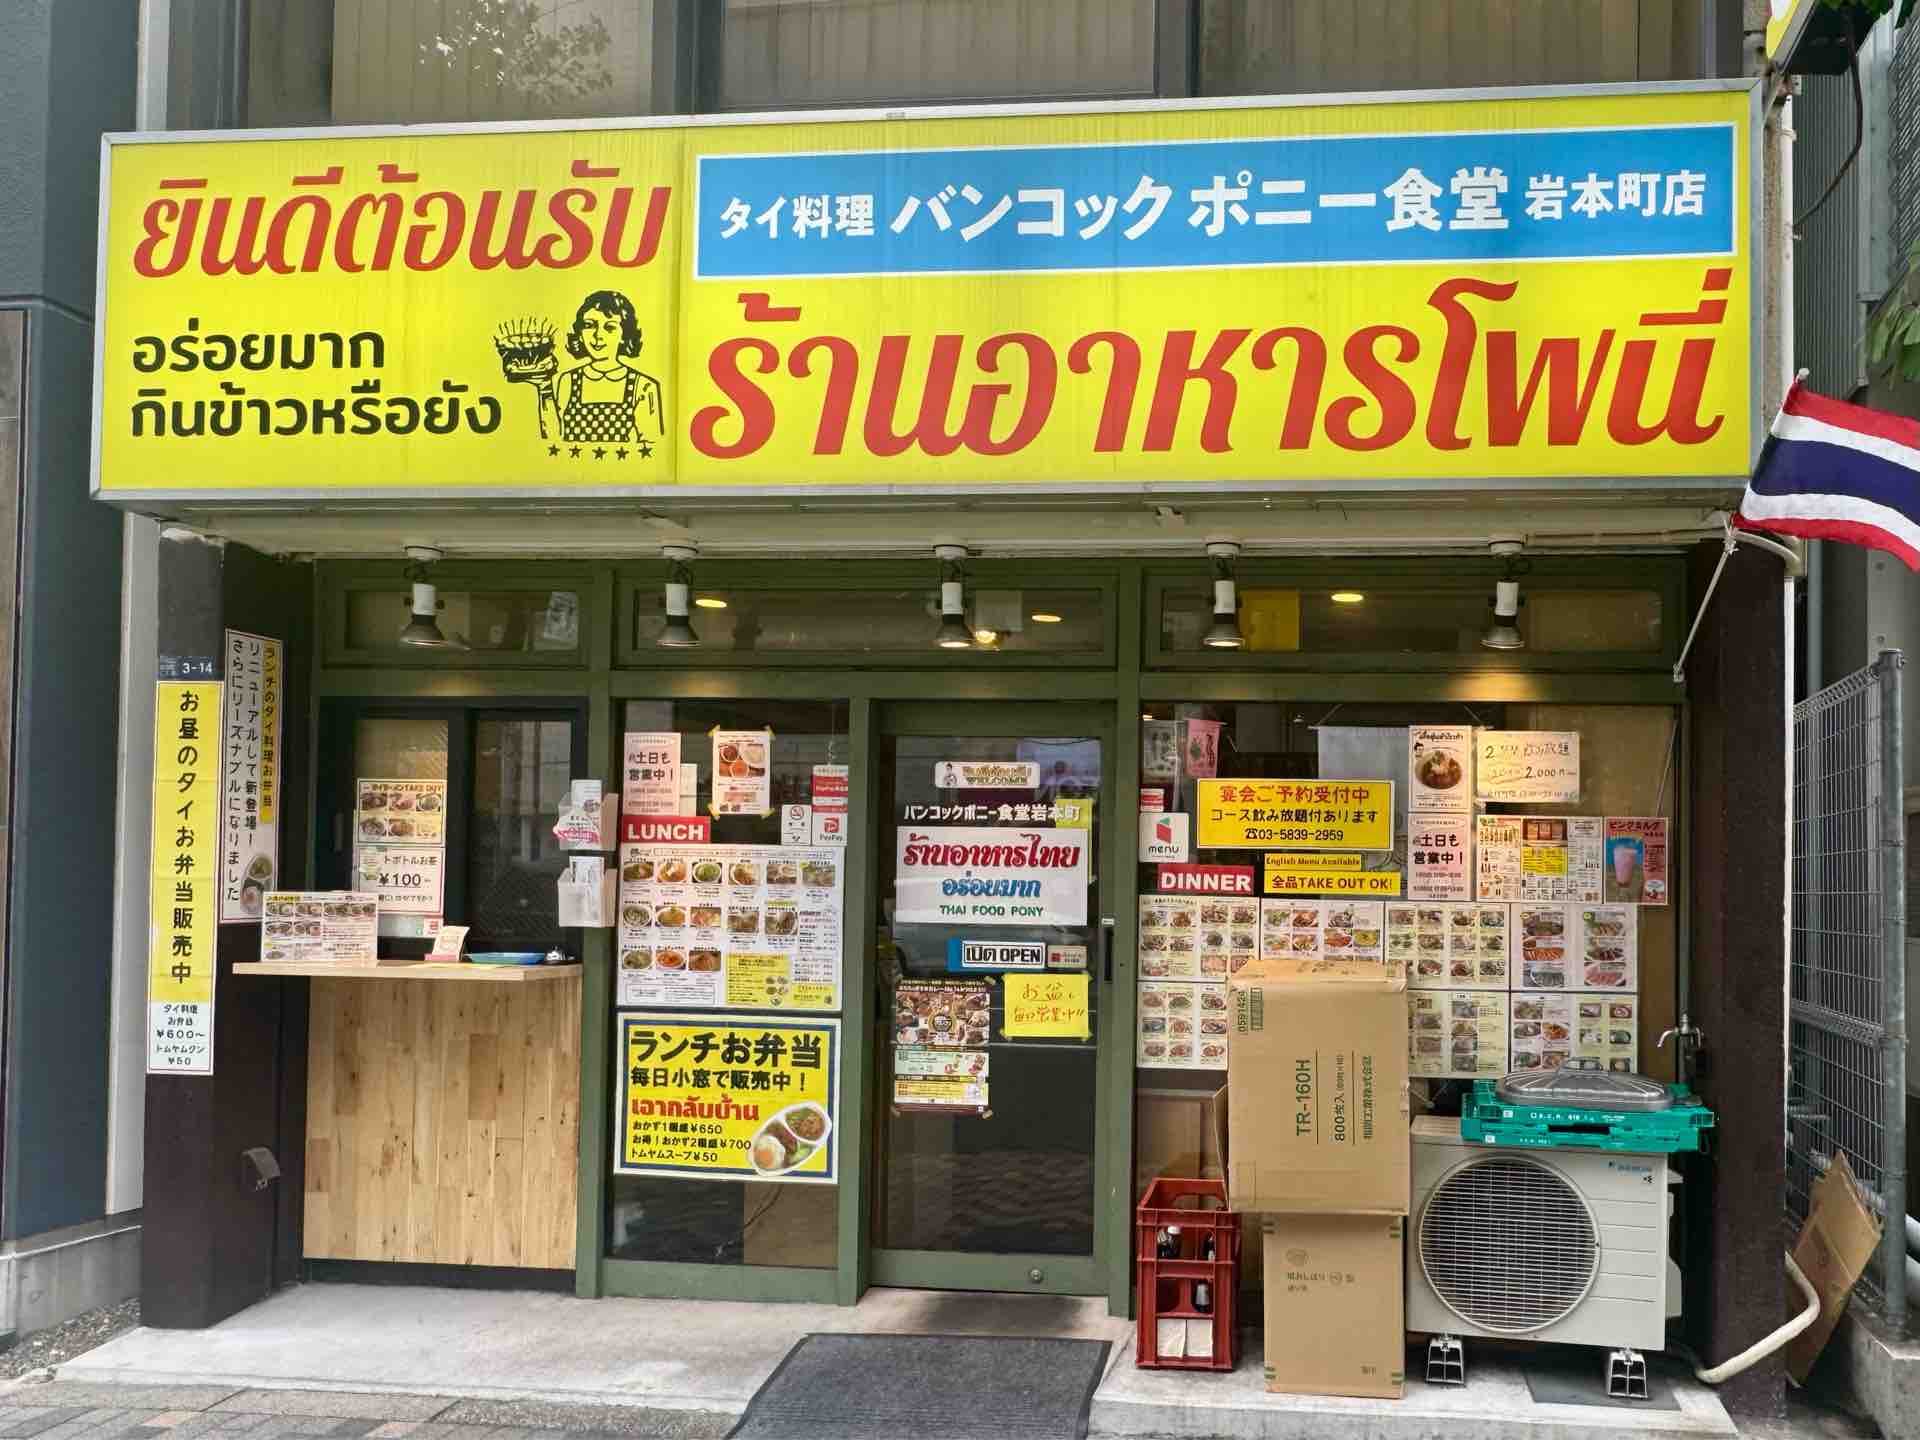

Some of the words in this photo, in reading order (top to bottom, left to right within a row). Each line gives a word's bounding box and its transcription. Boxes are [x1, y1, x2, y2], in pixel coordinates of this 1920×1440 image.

[720, 194, 875, 239] タイ料理
[890, 183, 1172, 242] バンコック
[1187, 167, 1510, 236] ポニー食堂
[1524, 169, 1707, 221] 岩本町店
[133, 160, 671, 277] ยินดีต้อนรับ
[132, 317, 385, 373] อร่อยมาก
[690, 267, 1734, 459] ร้านอาหารโพนี่
[130, 378, 502, 438] กินข้าวหรือยัง
[182, 662, 213, 673] 3-14
[1219, 784, 1370, 805] 宴会ご予約受付中
[903, 803, 1081, 822] バンコックポニー食堂岩本町
[1211, 808, 1379, 825] コース飲み放題付あります
[170, 690, 200, 985] お昼のタイお弁当販売中
[627, 823, 705, 841] LUNCH
[903, 832, 1081, 868] ร้านอาหารไทย
[1148, 845, 1180, 854] menu
[941, 870, 1042, 898] อร่อยมาก
[1160, 871, 1252, 891] DINNER
[1337, 877, 1366, 889] OUT
[939, 904, 967, 915] THAI
[972, 904, 1005, 916] FOOD
[1011, 904, 1044, 916] PONY
[1000, 947, 1041, 962] OPEN
[630, 1030, 822, 1070] ランチお弁当
[630, 1065, 806, 1092] 毎日小窓で販売中!
[631, 1093, 760, 1121] เอากลับบ้าน
[1295, 1058, 1312, 1137] TR-160H
